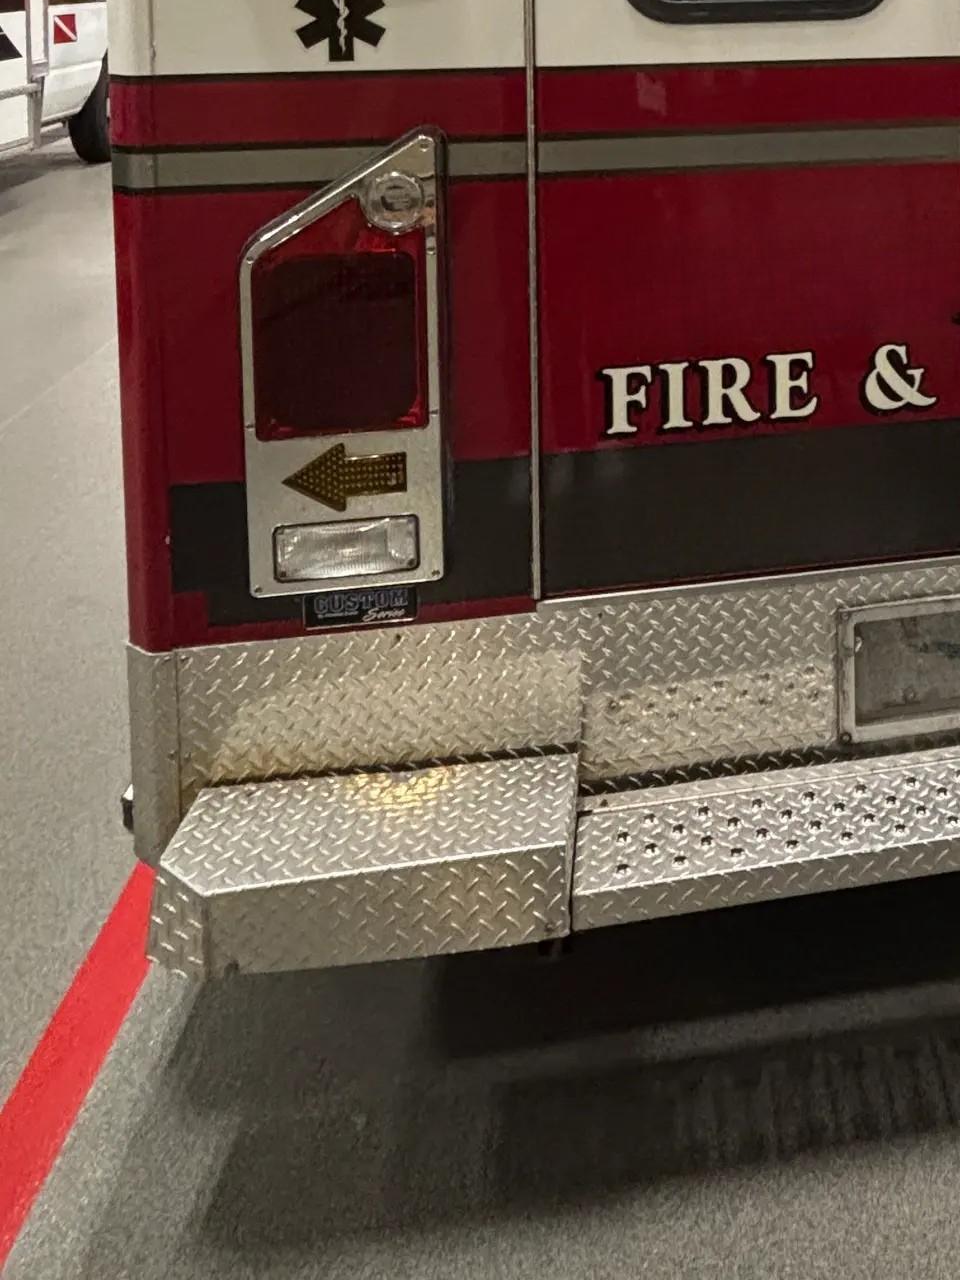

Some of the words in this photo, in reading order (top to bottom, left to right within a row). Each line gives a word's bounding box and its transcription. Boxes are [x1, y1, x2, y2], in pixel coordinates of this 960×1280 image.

[600, 350, 819, 435] FIRE
[863, 343, 938, 411] &
[313, 587, 409, 616] CUSTOM
